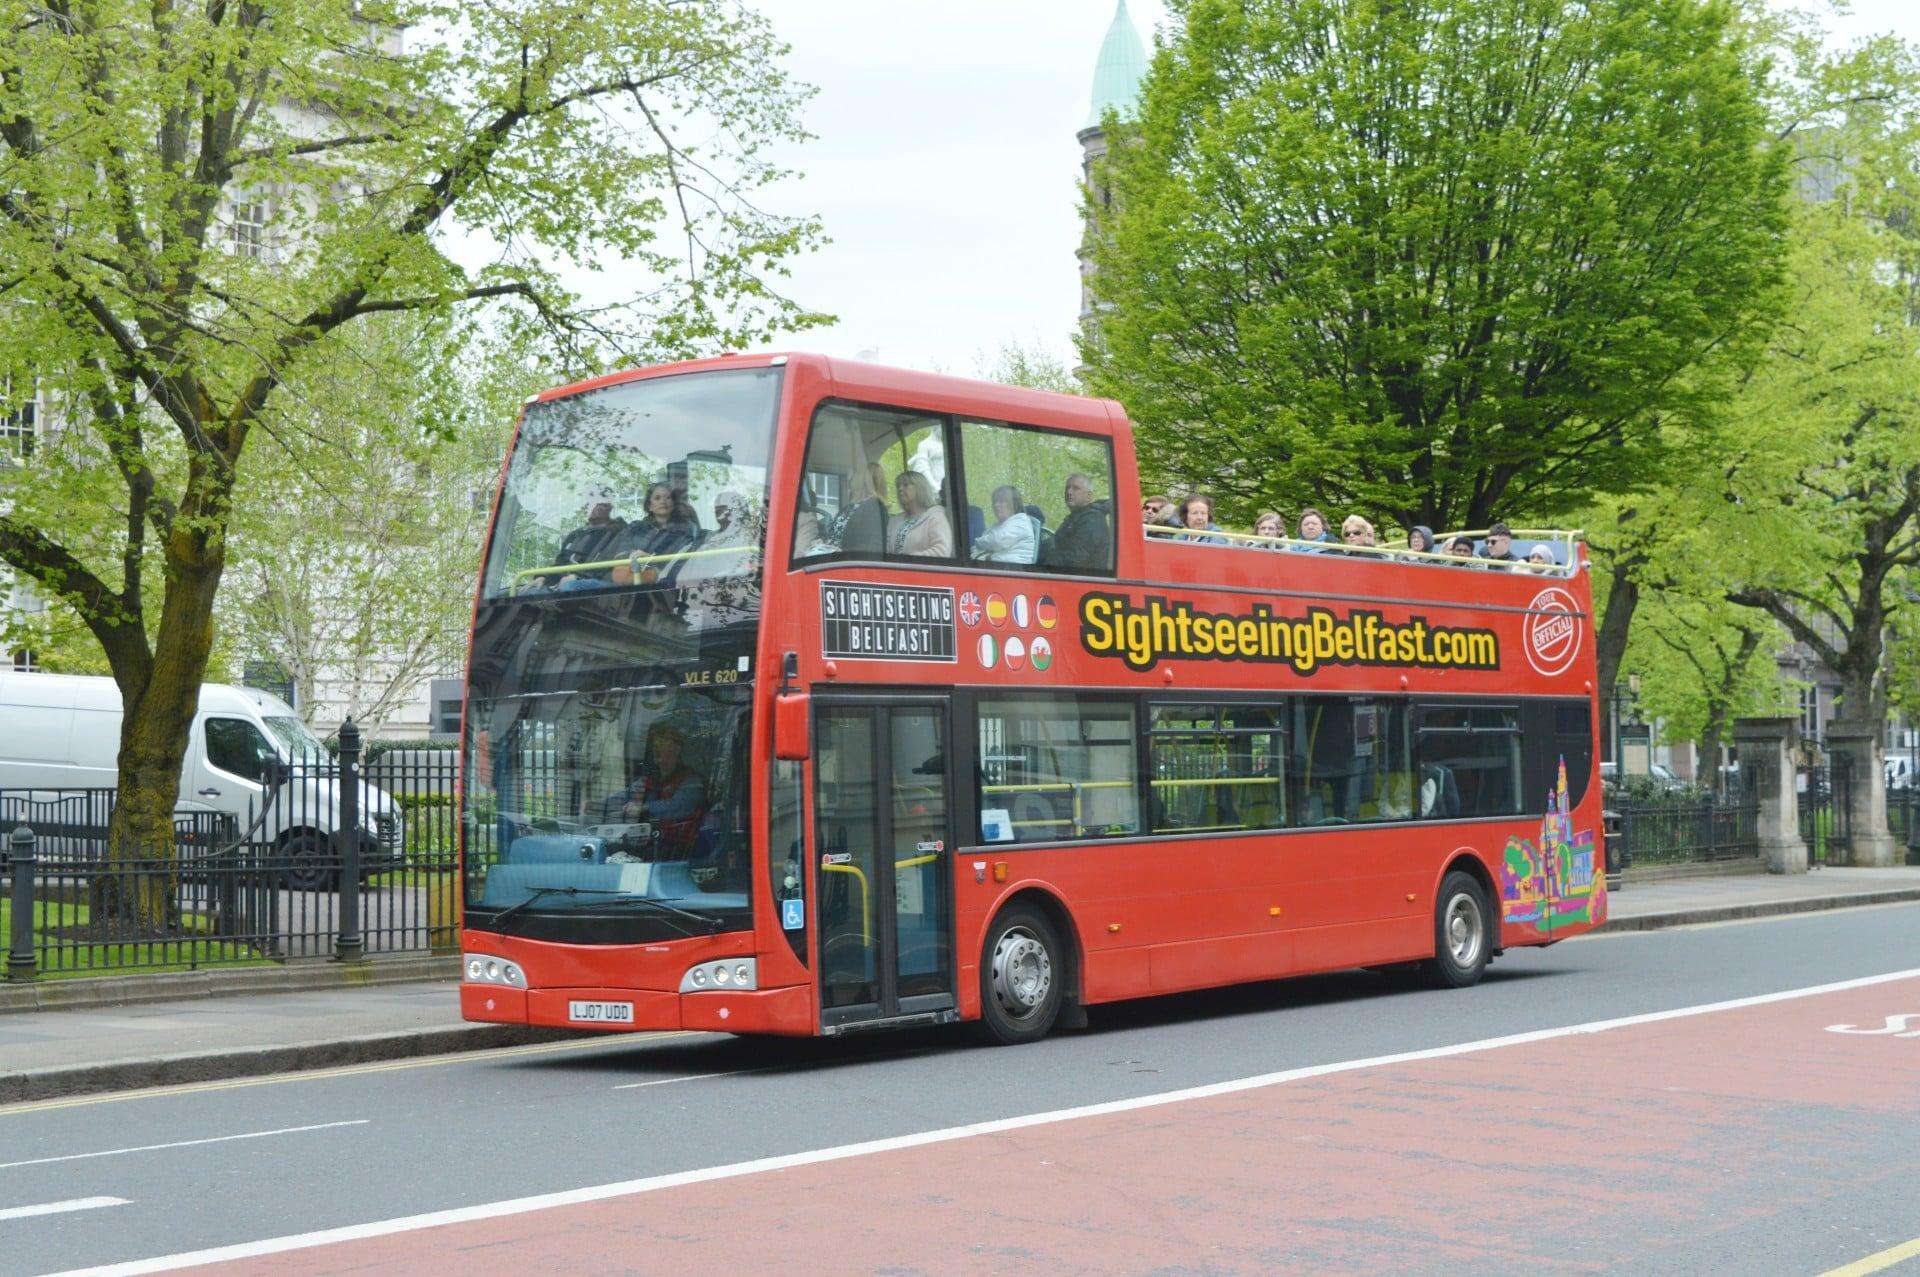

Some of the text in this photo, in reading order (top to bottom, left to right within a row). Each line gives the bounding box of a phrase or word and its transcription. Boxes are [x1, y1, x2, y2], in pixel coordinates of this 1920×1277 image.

[825, 590, 951, 620] SIGHTSEEING
[851, 625, 930, 652] BELFAST
[1084, 598, 1496, 671] SightseeingBelfast.com
[1534, 615, 1572, 647] OFFICIAL
[684, 669, 738, 685] VLE 620
[574, 1004, 629, 1020] LJ07 UDD
